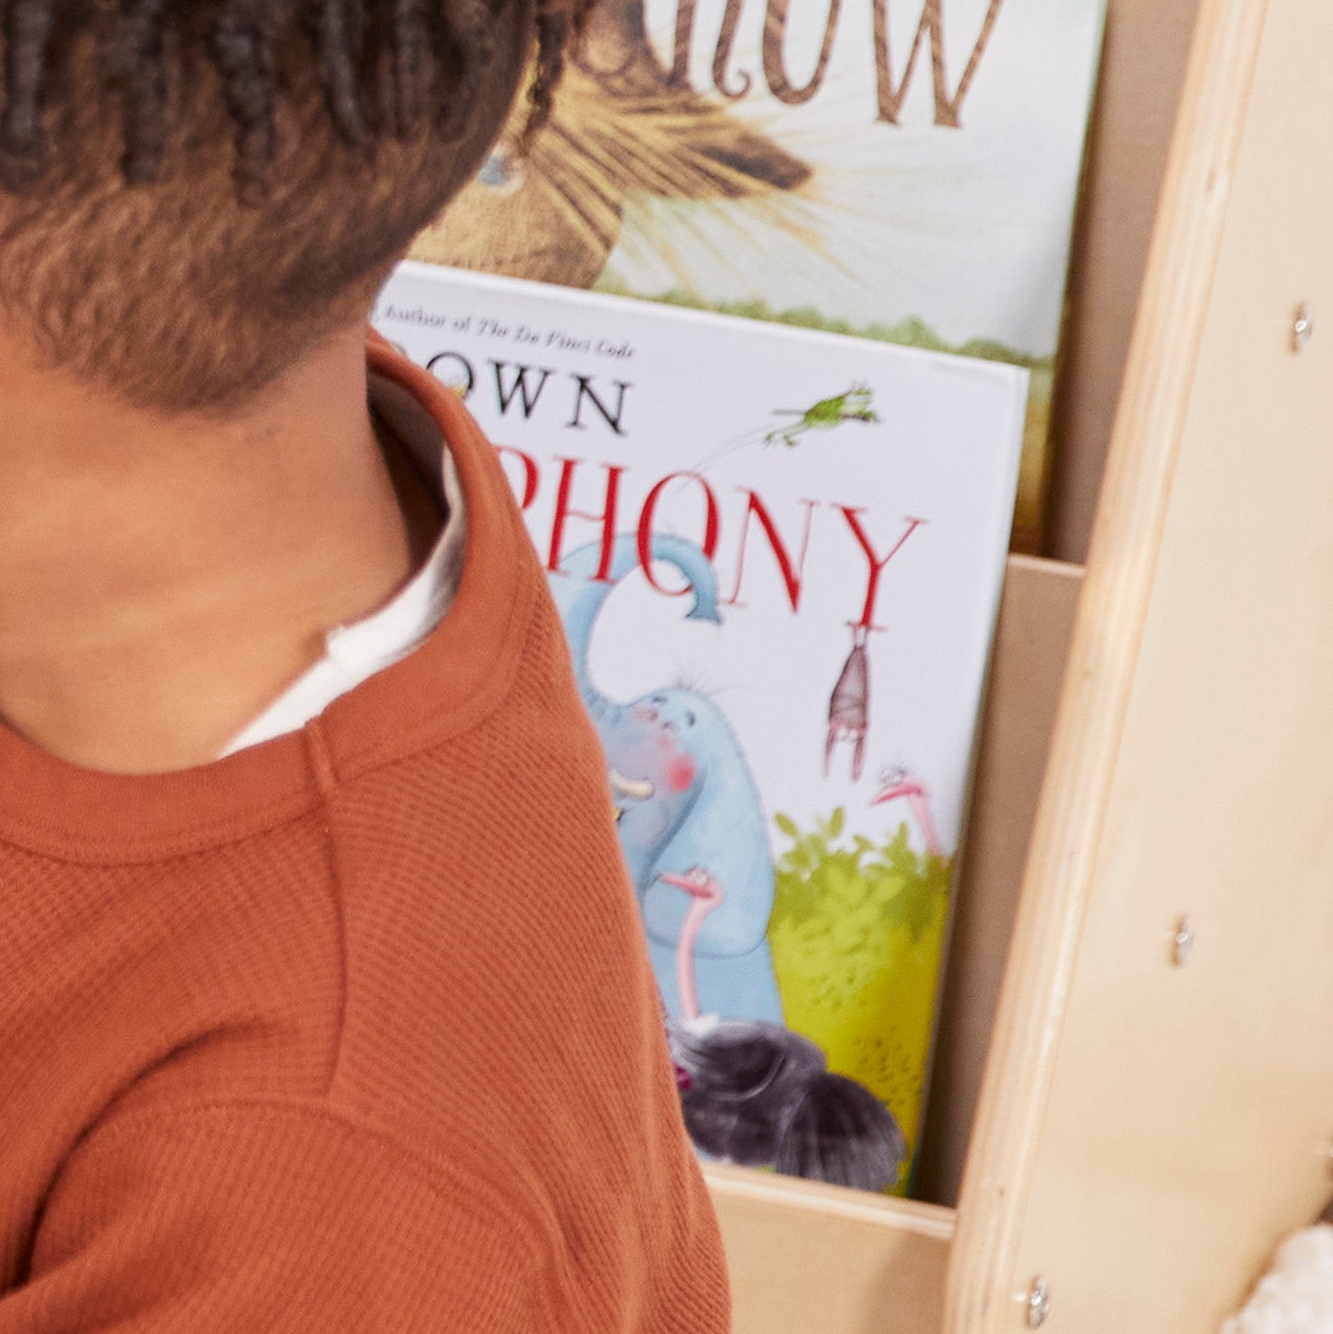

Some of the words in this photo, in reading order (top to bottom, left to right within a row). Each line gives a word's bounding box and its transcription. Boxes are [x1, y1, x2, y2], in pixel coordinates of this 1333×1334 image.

[386, 302, 446, 328] Author
[452, 315, 472, 332] of
[477, 319, 509, 338] The
[513, 324, 541, 344] Da
[596, 339, 637, 359] Code
[391, 343, 634, 436] OWN
